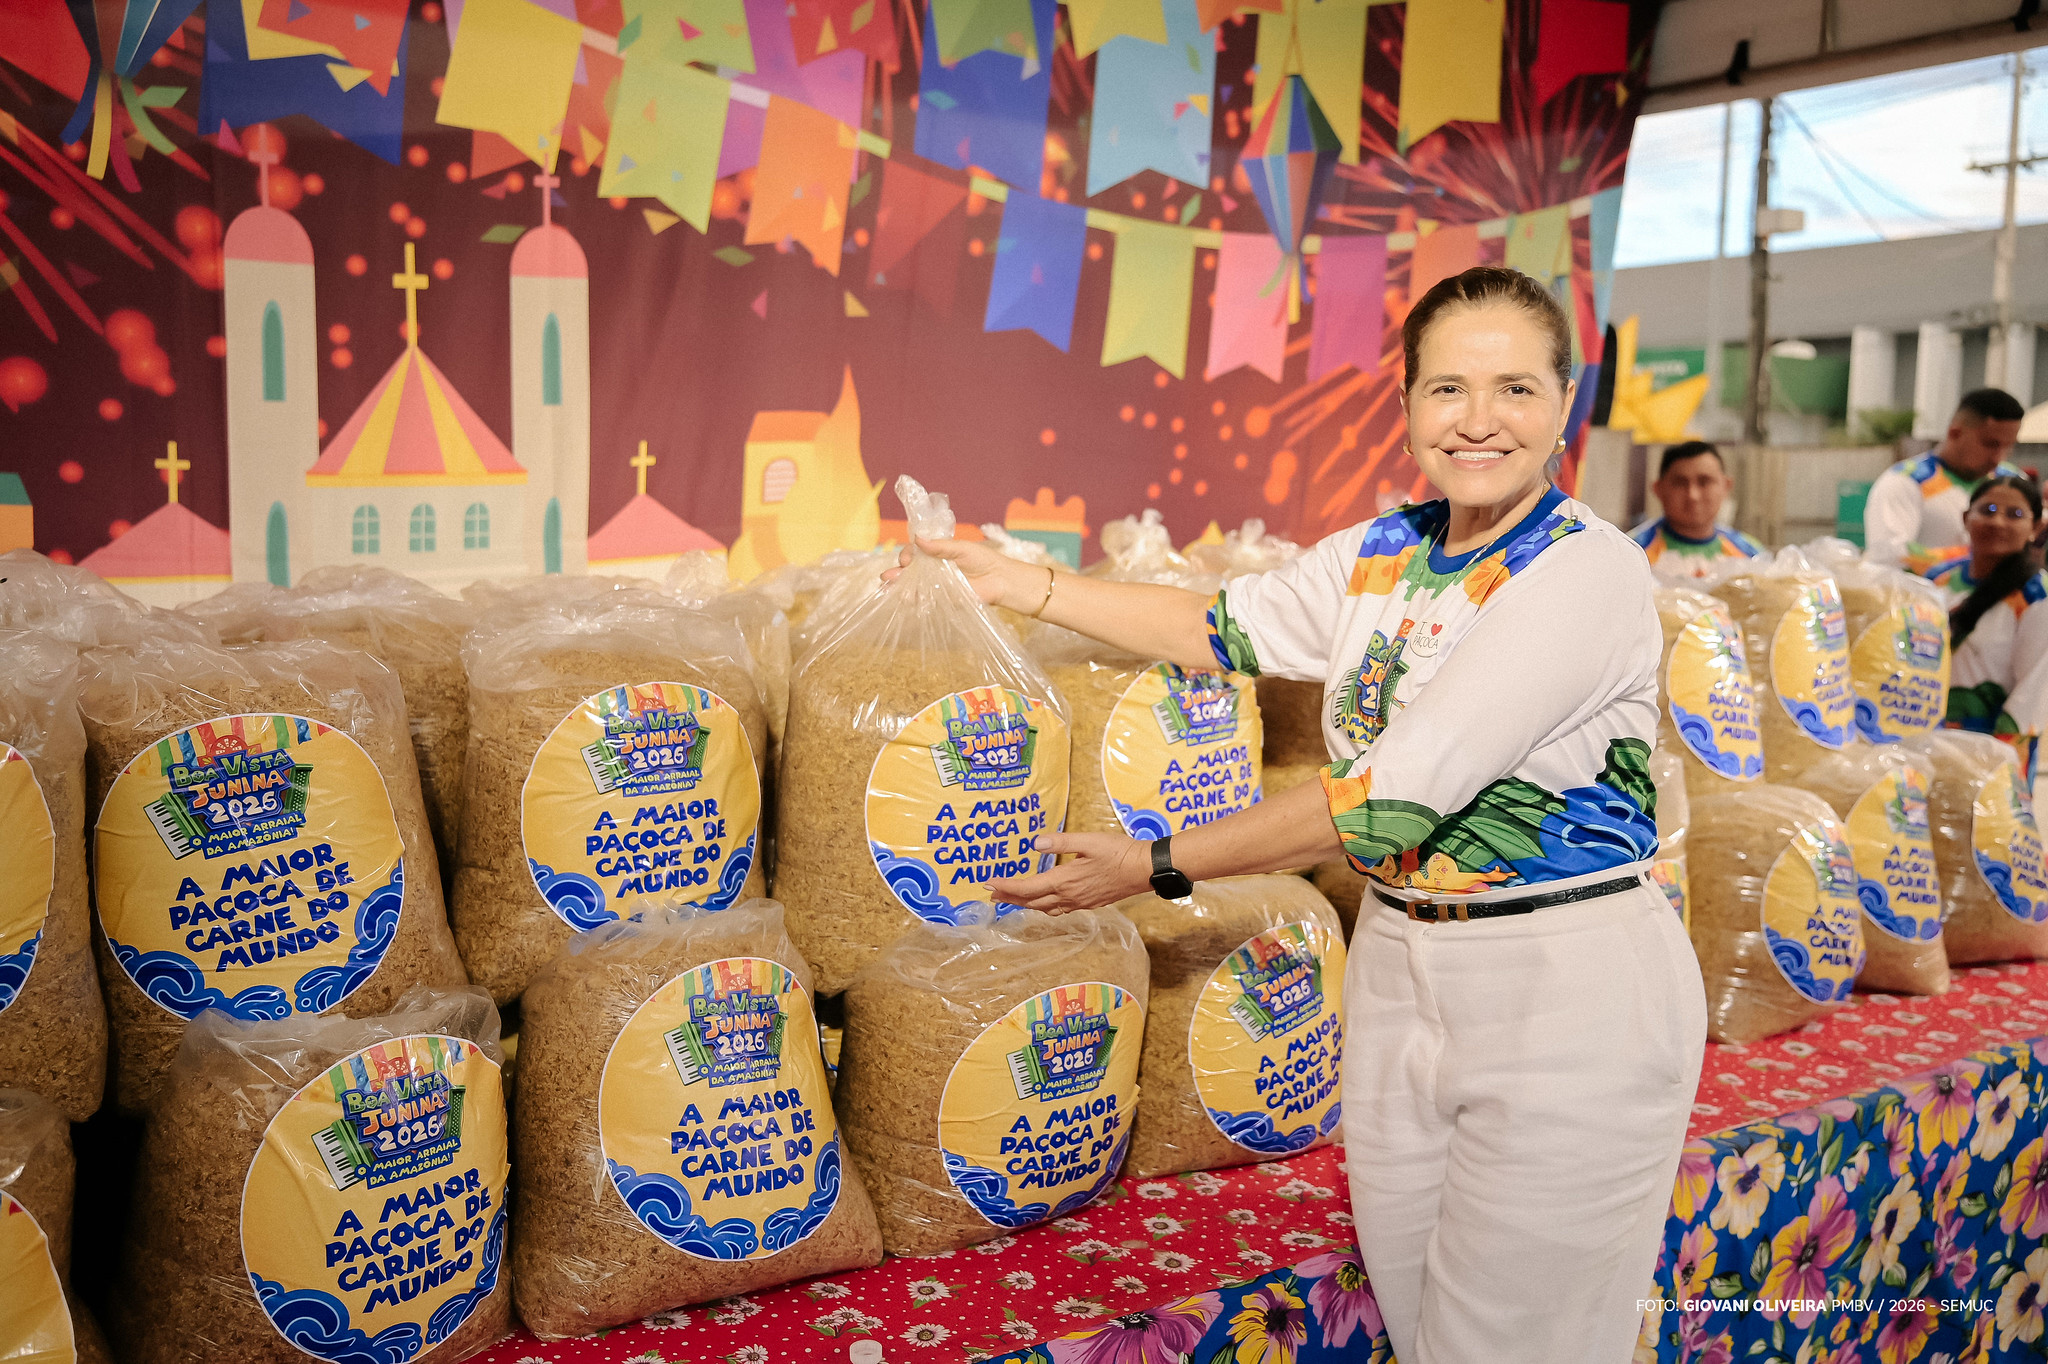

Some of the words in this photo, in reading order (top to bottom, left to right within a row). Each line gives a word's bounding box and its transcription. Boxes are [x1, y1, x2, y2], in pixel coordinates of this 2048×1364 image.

[1413, 636, 1439, 649] PAÇOCA
[1417, 622, 1427, 634] I
[609, 717, 644, 734] BOA
[647, 712, 695, 729] VISTA
[950, 721, 983, 737] BOA
[619, 729, 690, 754] JUNINA
[632, 747, 684, 768] 2026
[960, 729, 1023, 755] JUNINA
[173, 767, 219, 786] BOA
[221, 752, 288, 776] VISTA
[1166, 760, 1183, 775] A
[1192, 746, 1247, 769] MAIOR
[189, 770, 285, 808] JUNINA
[626, 787, 638, 795] DA
[628, 775, 660, 784] MAIOR
[664, 770, 700, 780] ARRAIAL
[1160, 769, 1233, 795] PAÇOCA
[1240, 762, 1251, 780] DE
[208, 791, 277, 823] 2026
[935, 803, 957, 821] A
[969, 793, 1040, 818] MAIOR
[1166, 789, 1226, 813] CARNE
[1234, 783, 1249, 800] DO
[193, 838, 201, 846] O
[209, 828, 248, 842] MAIOR
[253, 815, 302, 832] ARRAIAL
[594, 811, 617, 831] A
[632, 799, 719, 826] MAIOR
[927, 819, 1020, 843] PAÇOCA
[1029, 812, 1046, 832] DE
[228, 828, 294, 850] AMAZÔNIA!
[586, 825, 694, 856] PAÇOCA
[703, 819, 726, 841] DE
[934, 841, 1009, 864] CARNE
[176, 877, 204, 901] A
[221, 844, 336, 890] MAIOR
[595, 849, 682, 877] CARNE
[693, 843, 720, 864] DO
[950, 858, 1030, 885] MUNDO
[169, 879, 305, 930] PAÇOCA
[315, 862, 355, 892] DE
[616, 867, 709, 898] MUNDO
[185, 906, 296, 953] CARNE
[309, 891, 349, 921] DO
[216, 920, 339, 972] MUNDO
[1241, 970, 1273, 989] BOA
[1254, 963, 1312, 1002] JUNINA
[1270, 979, 1311, 1011] 2026
[694, 998, 730, 1017] BOA
[732, 993, 776, 1011] VISTA
[704, 1013, 771, 1039] JUNINA
[1035, 1024, 1065, 1040] BOA
[1067, 1016, 1107, 1033] VISTA
[718, 1032, 765, 1055] 2026
[1043, 1030, 1100, 1060] JUNINA
[1259, 1055, 1275, 1073] A
[1287, 1013, 1338, 1060] MAIOR
[714, 1062, 746, 1072] MAIOR
[1052, 1048, 1094, 1073] 2026
[1255, 1046, 1328, 1095] PAÇOCA
[1333, 1024, 1342, 1048] DE
[346, 1091, 391, 1113] BOA
[393, 1074, 446, 1100] VISTA
[712, 1076, 725, 1084] DA
[1046, 1078, 1072, 1089] MAIOR
[1266, 1066, 1325, 1109] CARNE
[1282, 1071, 1339, 1120] MUNDO
[361, 1093, 444, 1135] JUNINA
[678, 1103, 704, 1126] A
[718, 1087, 803, 1120] MAIOR
[1010, 1116, 1031, 1133] A
[1044, 1094, 1117, 1129] MAIOR
[378, 1115, 439, 1151] 2026
[671, 1117, 783, 1154] PAÇOCA
[791, 1109, 815, 1134] DE
[1000, 1124, 1093, 1154] PAÇOCA
[1102, 1112, 1120, 1134] DE
[358, 1167, 366, 1175] O
[373, 1155, 412, 1171] MAIOR
[417, 1139, 458, 1160] ARRAIAL
[370, 1175, 386, 1185] DA
[390, 1154, 450, 1179] AMAZÔNIA!
[681, 1143, 774, 1178] CARNE
[784, 1136, 812, 1162] DO
[1006, 1147, 1081, 1175] CARNE
[1090, 1135, 1114, 1158] DO
[703, 1163, 804, 1200] MUNDO
[1019, 1159, 1101, 1189] MUNDO
[334, 1210, 363, 1236] A
[379, 1168, 481, 1223] MAIOR
[326, 1208, 454, 1267] PAÇOCA
[465, 1187, 491, 1221] DE
[338, 1238, 442, 1292] CARNE
[455, 1218, 485, 1251] DO
[363, 1250, 473, 1313] MUNDO
